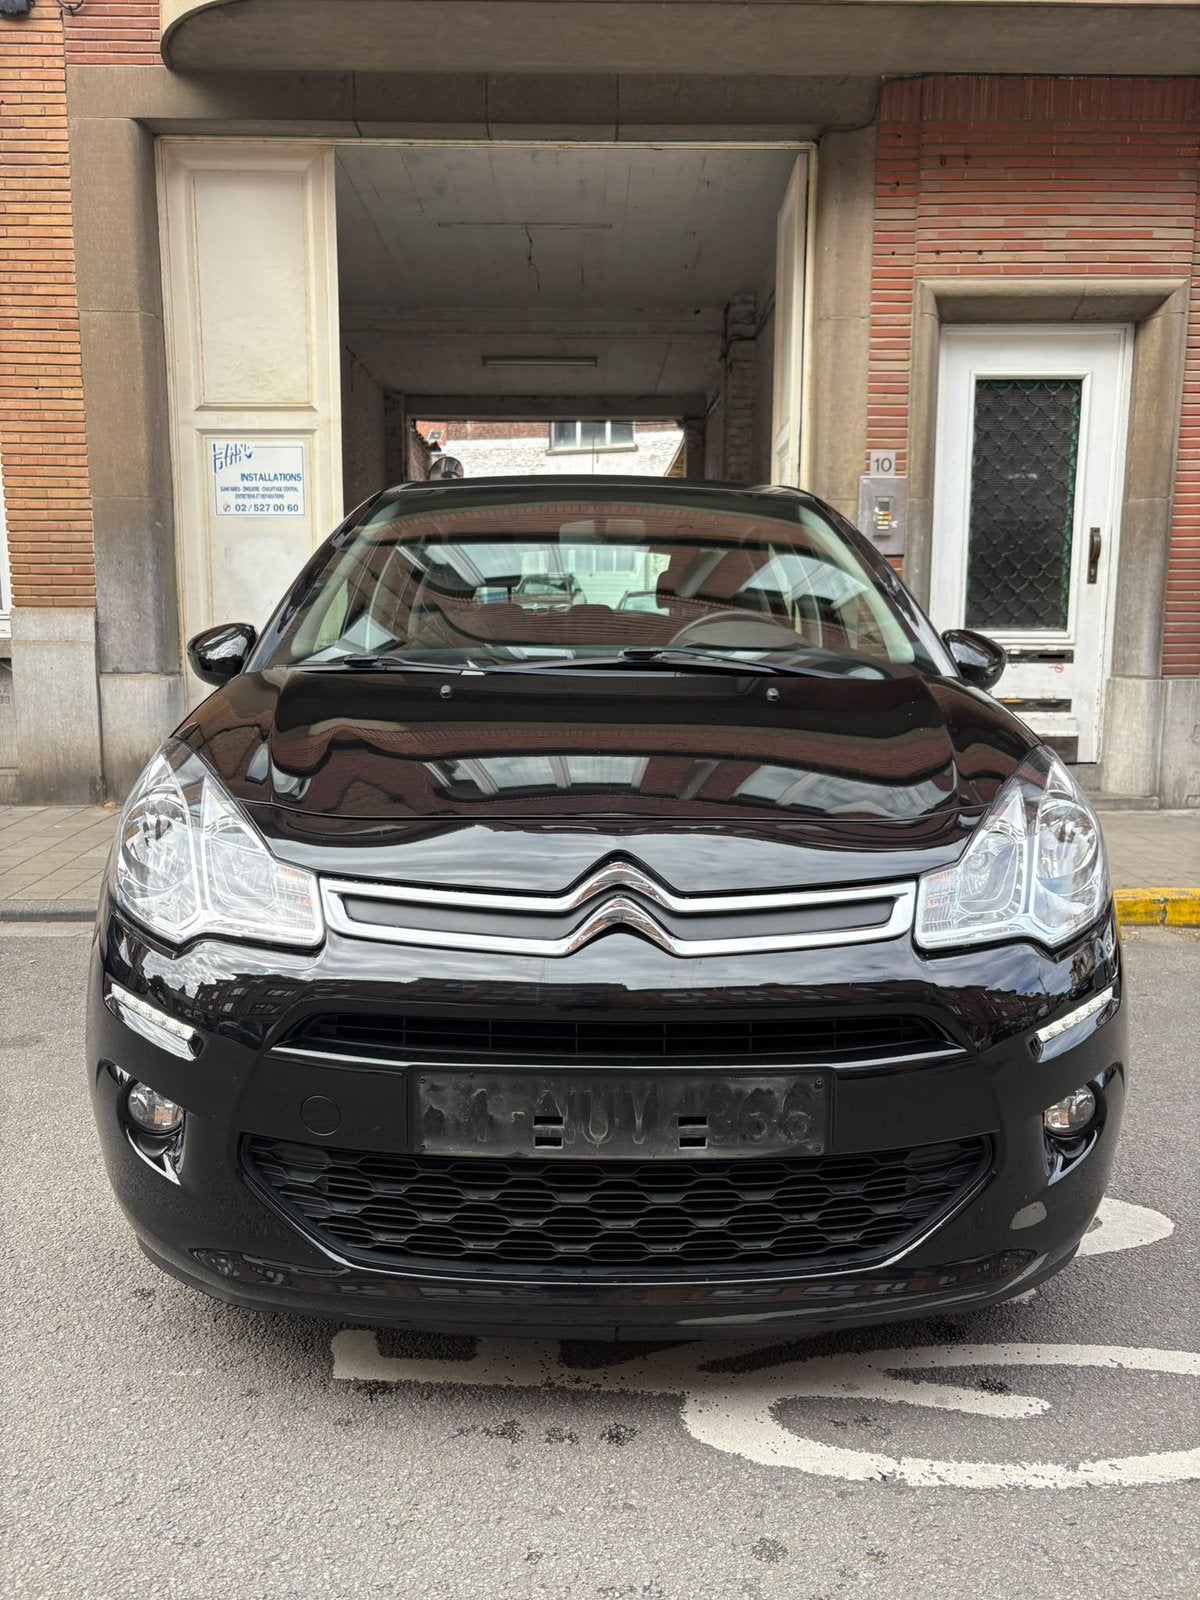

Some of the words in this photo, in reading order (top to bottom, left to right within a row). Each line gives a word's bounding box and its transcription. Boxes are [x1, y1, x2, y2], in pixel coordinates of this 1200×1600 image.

[873, 458, 893, 472] 10
[240, 473, 302, 482] INSTALLATIONS
[273, 503, 285, 512] 00
[287, 503, 299, 512] 60
